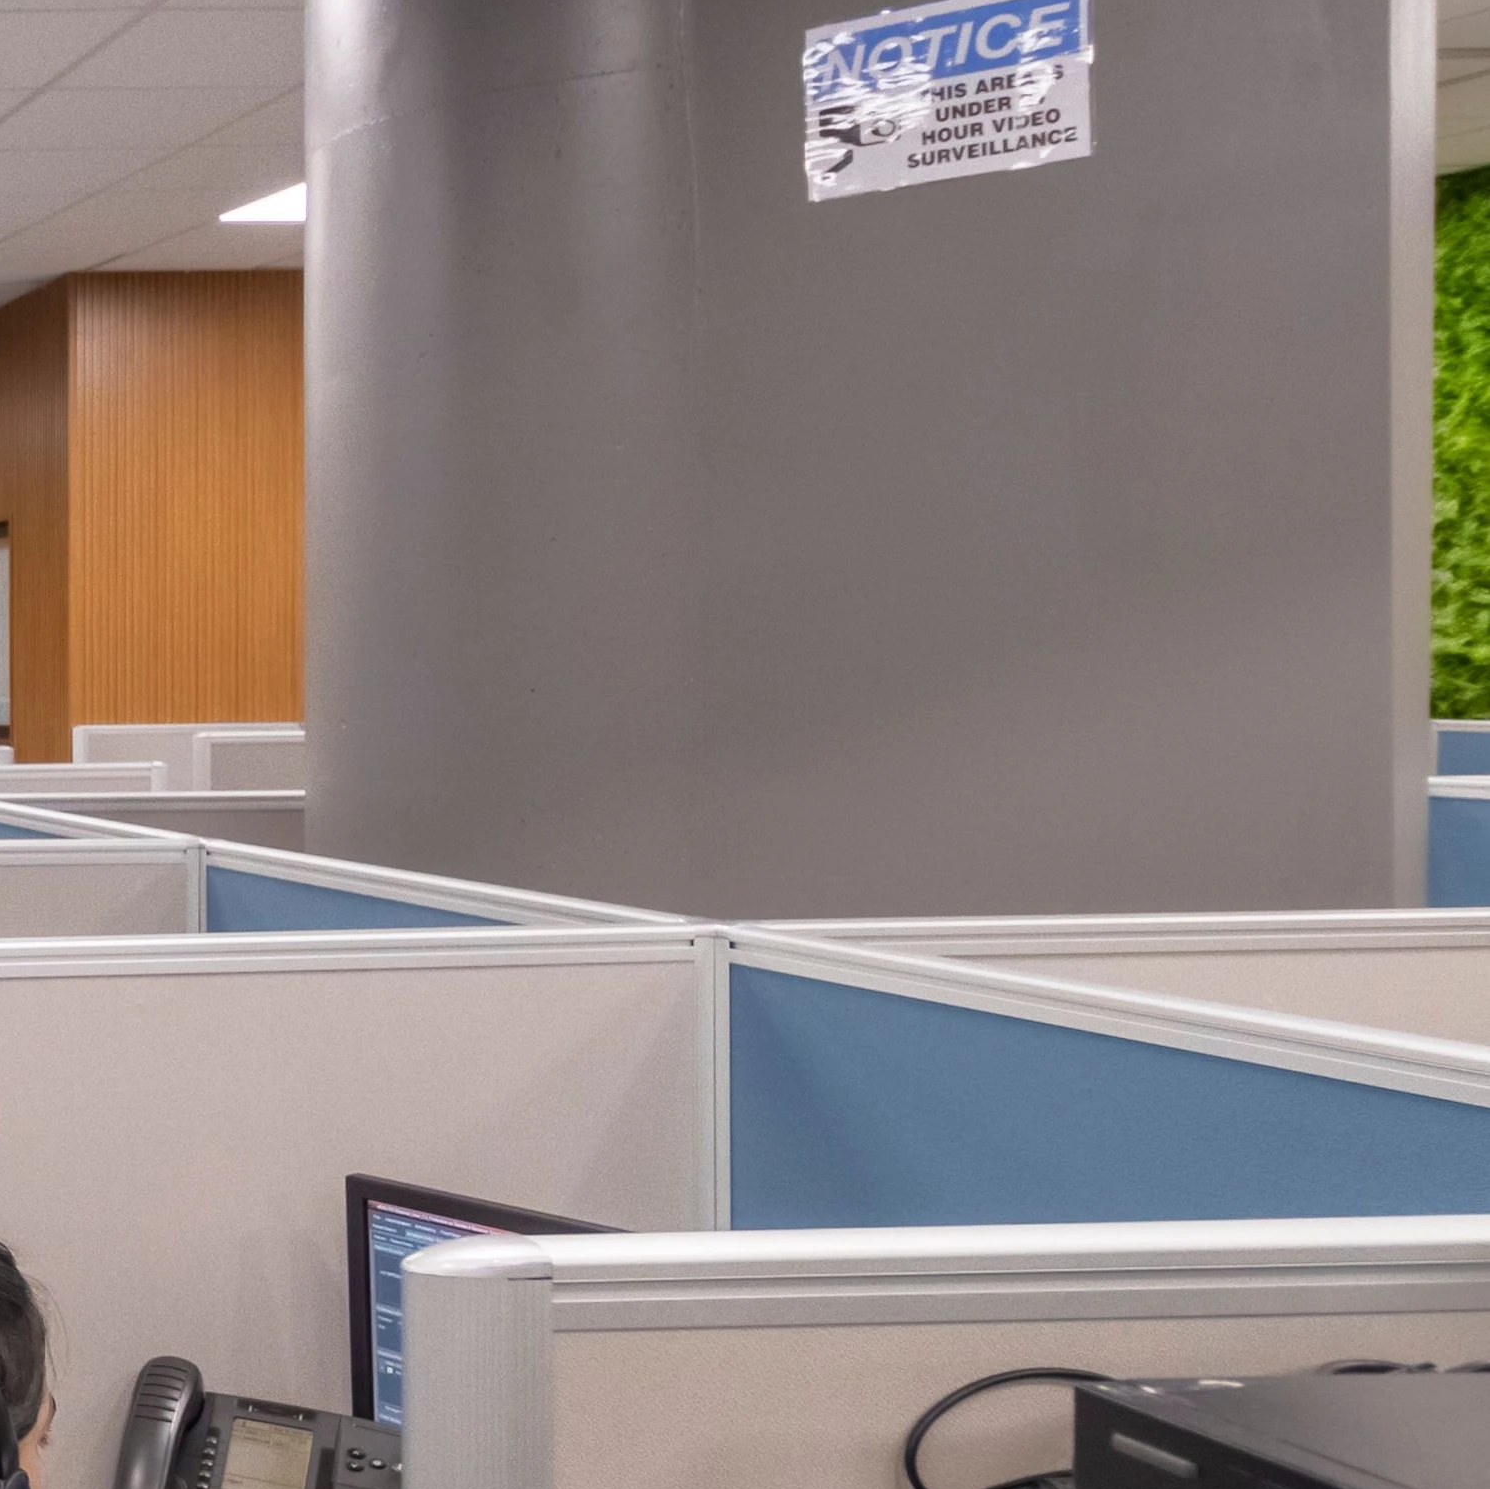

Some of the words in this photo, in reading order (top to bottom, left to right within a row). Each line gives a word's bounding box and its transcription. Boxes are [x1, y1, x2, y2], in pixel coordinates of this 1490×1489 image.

[819, 1, 1071, 88] NOTICE
[922, 83, 967, 103] HIS
[935, 96, 1012, 123] UNDER
[907, 125, 1079, 169] SURVEILLANCE
[921, 121, 984, 146] HOUR
